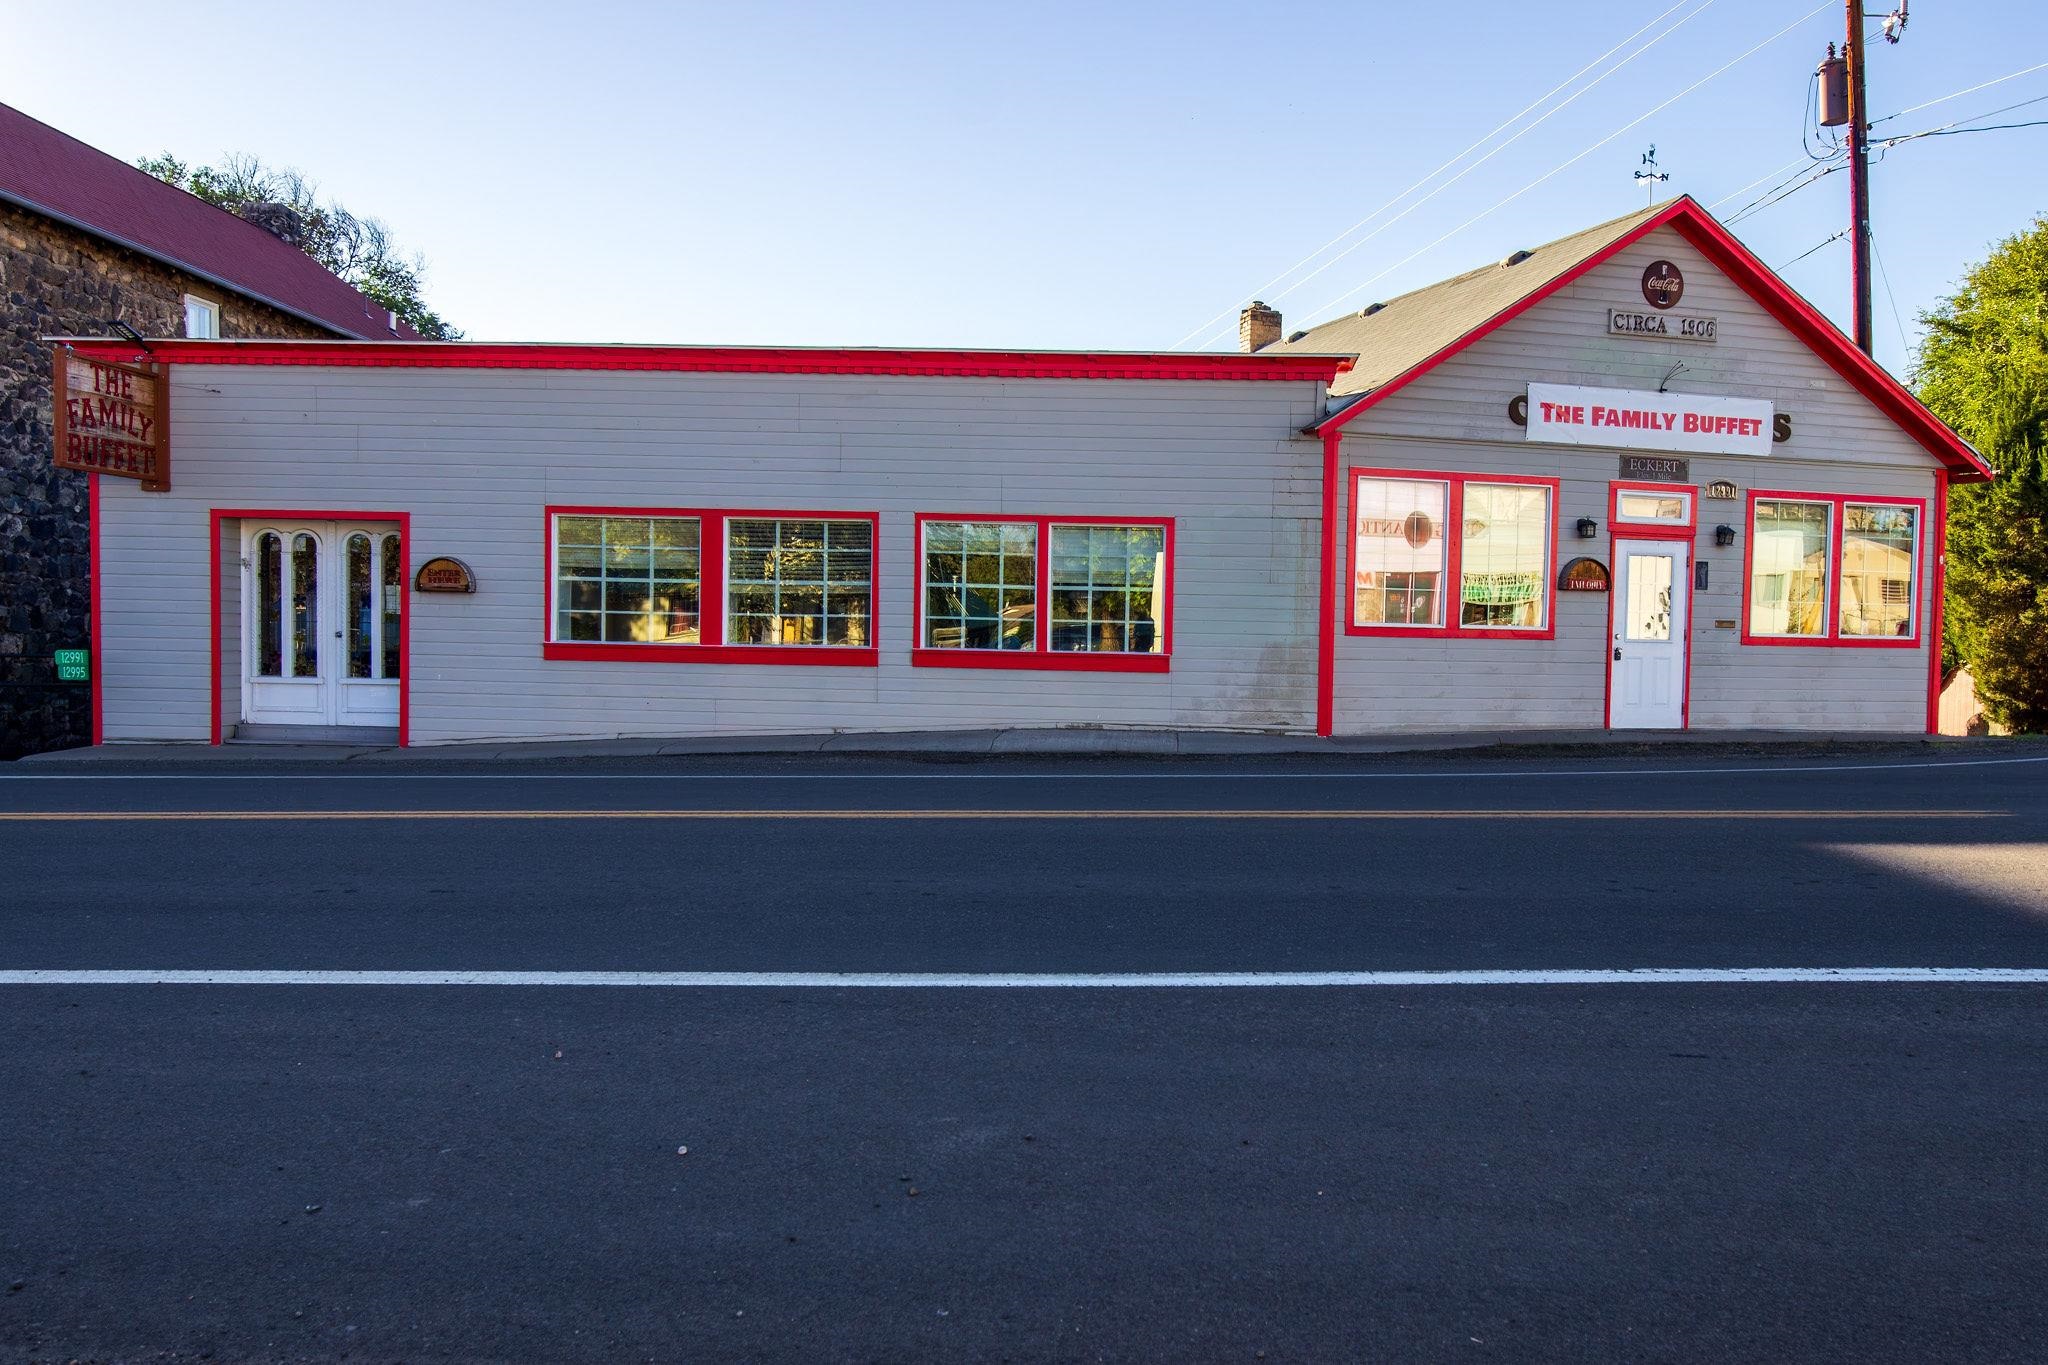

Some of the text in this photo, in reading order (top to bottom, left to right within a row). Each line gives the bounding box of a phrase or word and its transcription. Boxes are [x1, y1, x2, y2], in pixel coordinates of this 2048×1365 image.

[1613, 313, 1668, 334] CIRCA
[90, 362, 134, 400] THE
[66, 397, 154, 442] FAMILY
[1540, 402, 1585, 425] THE
[1591, 406, 1678, 431] FAMILY
[1683, 413, 1763, 437] BUFFET
[67, 433, 156, 474] BUFFET
[1630, 458, 1680, 473] ECKERT
[60, 652, 84, 664] 12991
[63, 666, 86, 678] 12995
